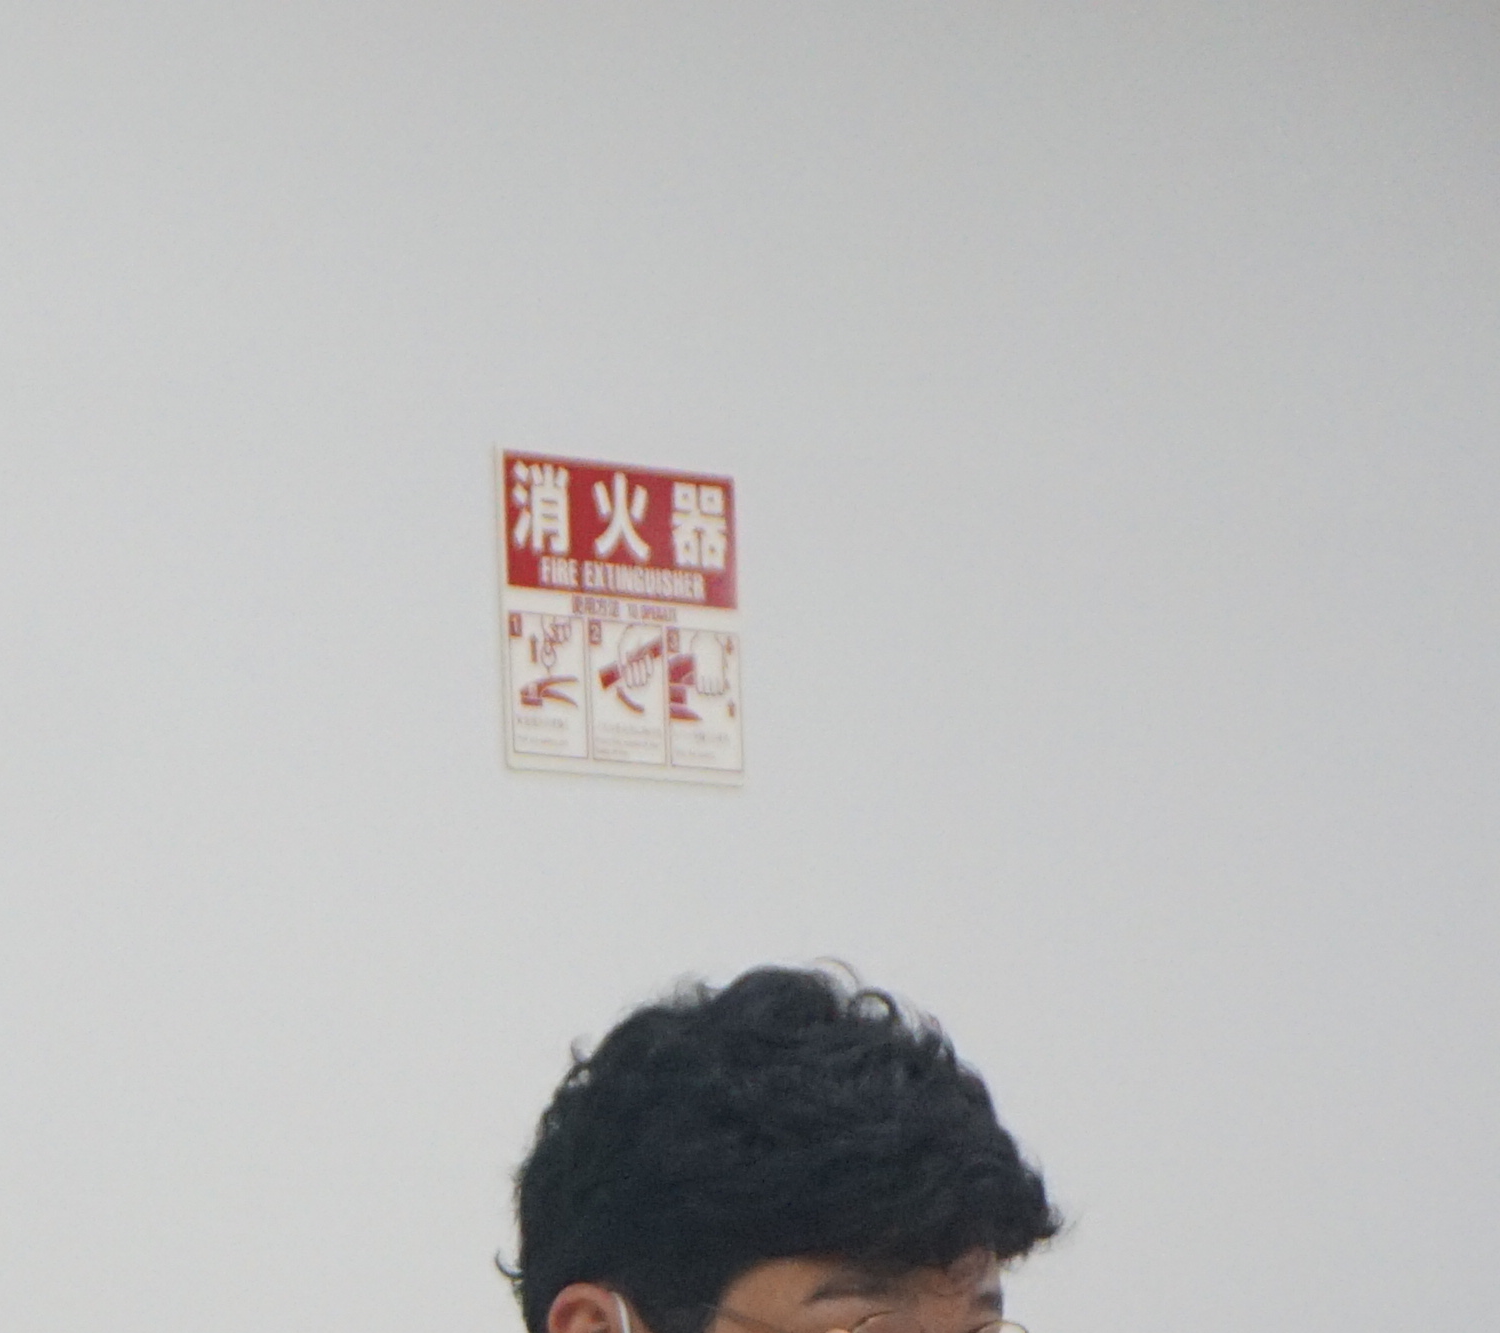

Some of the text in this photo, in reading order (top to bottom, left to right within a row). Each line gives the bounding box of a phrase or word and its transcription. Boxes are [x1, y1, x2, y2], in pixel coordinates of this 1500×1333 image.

[512, 459, 728, 572] 消火器
[540, 555, 706, 602] FIRE EXTINGUISHER
